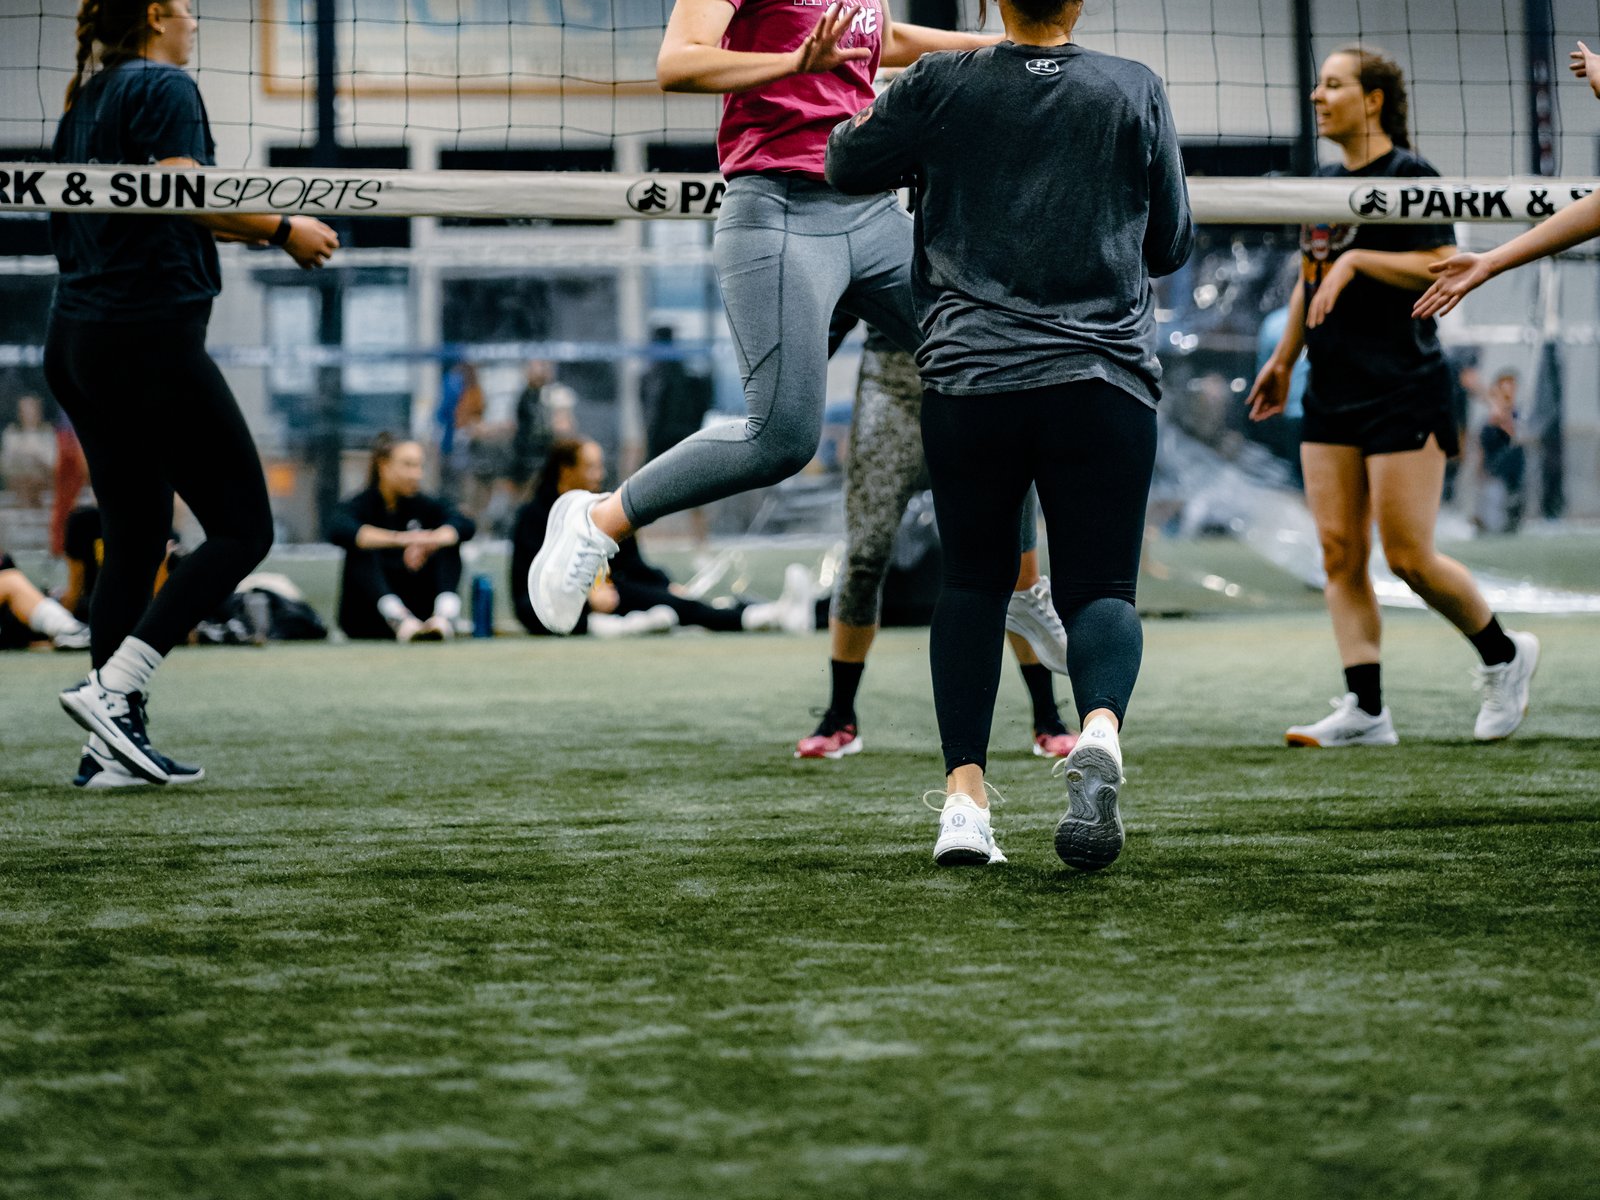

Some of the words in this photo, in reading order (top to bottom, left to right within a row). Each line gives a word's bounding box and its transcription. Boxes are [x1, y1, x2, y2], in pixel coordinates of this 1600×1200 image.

[61, 172, 94, 206] &
[109, 173, 206, 208] SUN
[1400, 186, 1512, 218] PARK
[1526, 187, 1555, 218] &
